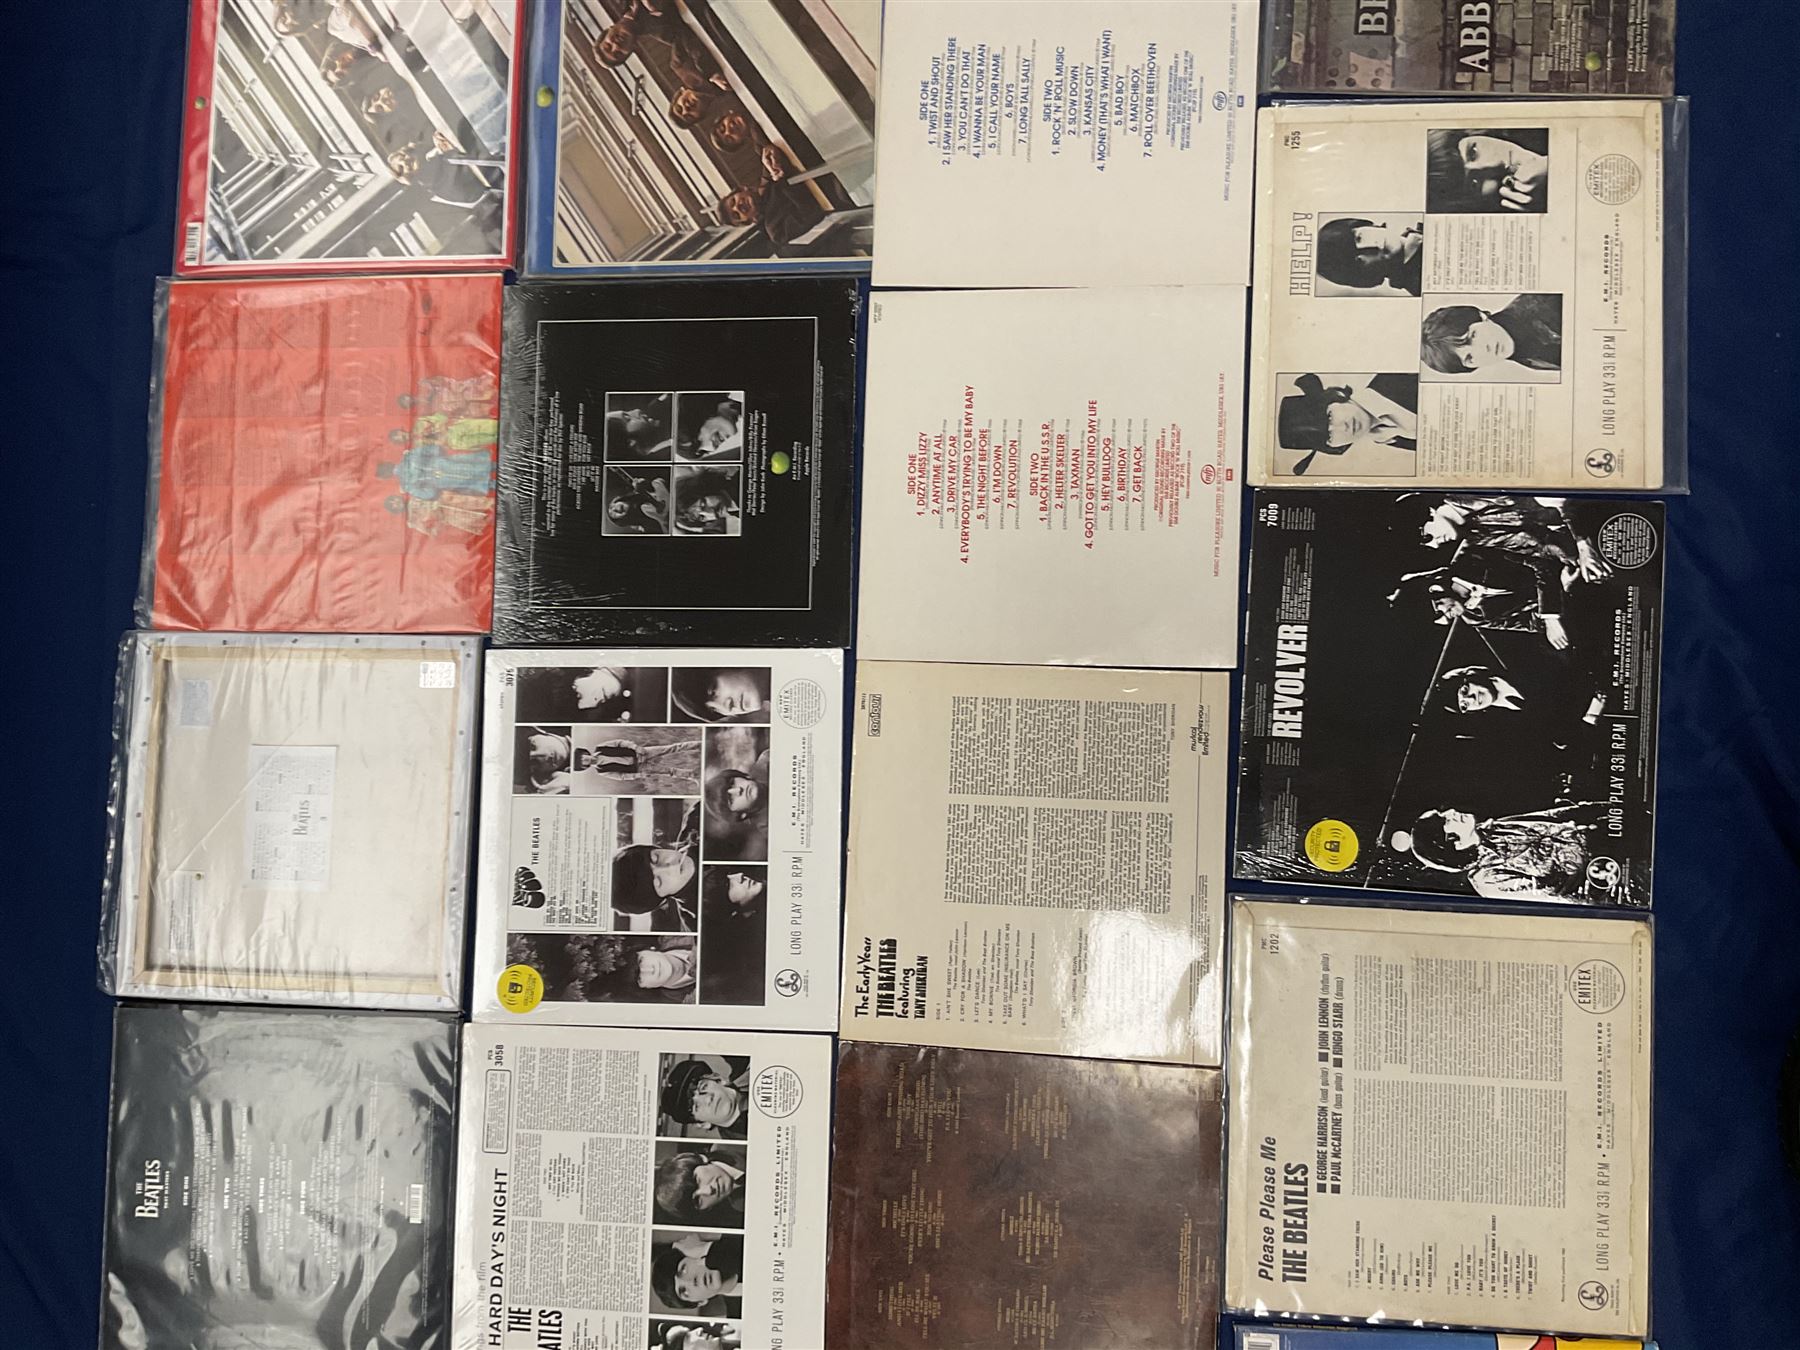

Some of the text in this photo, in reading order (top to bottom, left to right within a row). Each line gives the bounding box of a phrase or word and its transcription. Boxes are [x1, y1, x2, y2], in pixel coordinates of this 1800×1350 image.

[1459, 0, 1491, 71] ABB
[947, 38, 956, 61] THERE
[961, 52, 970, 71] THAT
[931, 57, 940, 86] SHOUT
[960, 74, 969, 88] DO
[930, 88, 938, 108] AND
[945, 64, 955, 110] STANDING
[919, 81, 929, 121] SIDE ONE
[959, 91, 969, 119] CAN'T
[929, 111, 939, 134] TWIST
[944, 112, 954, 129] HER
[958, 122, 967, 141] YOU
[943, 131, 951, 150] SAW
[1291, 131, 1301, 149] 1255
[1290, 212, 1313, 296] HELP!
[965, 386, 973, 409] BABY
[1602, 382, 1616, 405] PLAY
[964, 412, 973, 426] MY
[1602, 410, 1615, 435] LONG
[918, 433, 928, 455] LIZZY
[934, 434, 943, 450] ALL
[948, 436, 958, 457] CAR
[963, 441, 973, 452] TO
[964, 429, 972, 438] BE
[978, 430, 988, 462] BEFORE
[918, 458, 927, 478] MISS
[933, 453, 942, 462] AT
[948, 459, 957, 474] MY
[993, 446, 1002, 477] DOWN
[1007, 440, 1018, 498] REVOLUTION
[907, 455, 917, 495] SIDE ONE
[932, 465, 942, 504] ANYTIME
[962, 456, 973, 488] TRYING
[978, 465, 987, 492] NIGHT
[917, 481, 927, 506] DIZZY
[947, 476, 957, 503] DRIVE
[993, 479, 1002, 493] I'M
[977, 495, 987, 509] THE
[1268, 504, 1278, 526] 7009
[961, 491, 972, 553] EVERYBODY'S
[1606, 524, 1614, 557] EMITEX
[1272, 624, 1308, 738] REVOLVER
[870, 696, 881, 735] contour
[1609, 776, 1624, 803] PLAY
[292, 800, 311, 835] BEATLES
[1608, 809, 1623, 837] LONG
[531, 818, 540, 865] THE BEATLES
[790, 903, 802, 925] PLAY
[790, 931, 801, 955] LONG
[1270, 934, 1279, 954] 1202
[855, 937, 876, 1017] The Early Years
[876, 939, 897, 1018] THE BEATLES
[914, 956, 928, 1019] TONY SHERIDAN
[1578, 969, 1592, 1004] EMITEX
[895, 968, 915, 1018] featuring
[1319, 998, 1329, 1027] LENNON
[1333, 1003, 1343, 1028] STARR
[1319, 1031, 1329, 1050] JOHN
[1333, 1031, 1343, 1055] RINGO
[495, 1044, 504, 1066] 3058
[761, 1074, 773, 1107] EMITEX
[1318, 1106, 1328, 1147] HARRISON
[1332, 1112, 1342, 1158] McCARTNEY
[1317, 1150, 1327, 1180] GEORGE
[1332, 1162, 1342, 1181] PAUL
[135, 1160, 163, 1218] BEATLES
[1258, 1137, 1276, 1281] Please Please Me
[1282, 1163, 1308, 1282] THE BEATLES
[1596, 1213, 1609, 1238] PLAY
[489, 1168, 507, 1346] HARD DAY'S NIGHT
[1596, 1244, 1609, 1271] LONG
[508, 1307, 532, 1332] THE
[772, 1309, 783, 1332] PLAY
